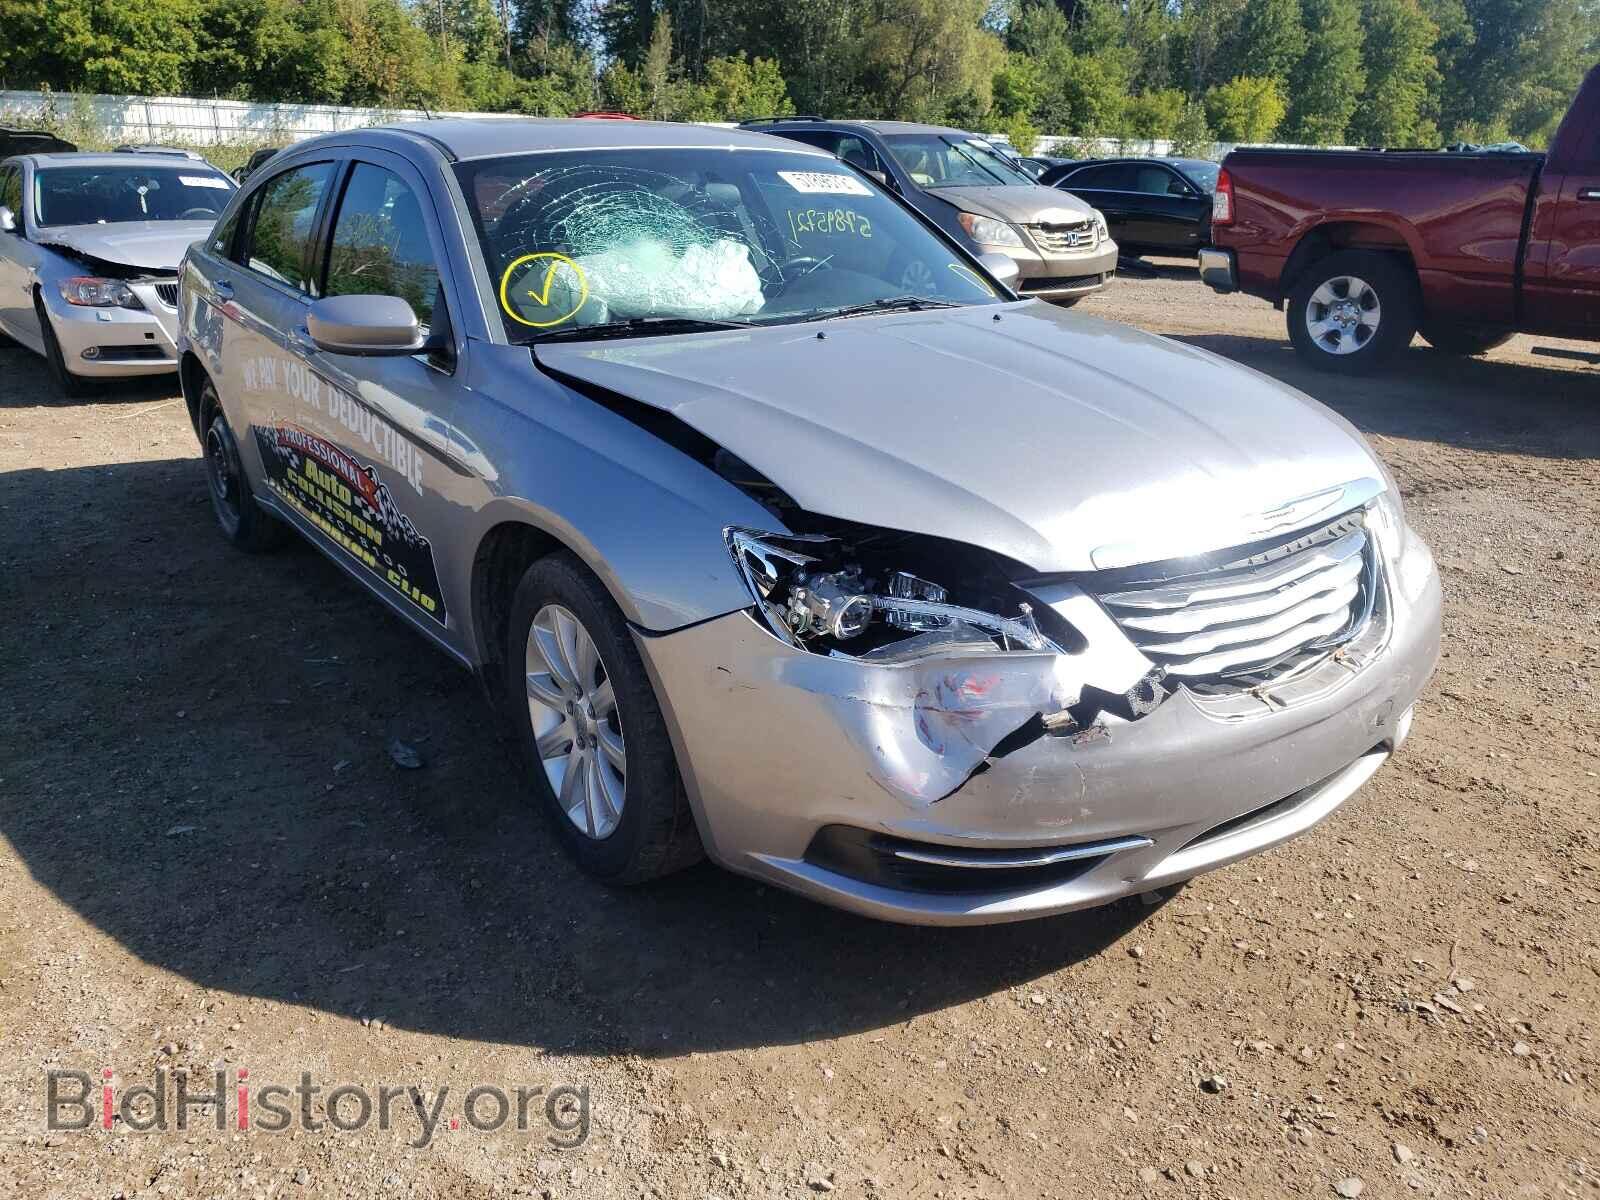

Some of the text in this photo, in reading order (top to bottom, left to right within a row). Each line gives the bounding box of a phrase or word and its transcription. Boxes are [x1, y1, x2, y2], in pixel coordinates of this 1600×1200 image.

[282, 359, 320, 410] YOUR
[328, 384, 424, 497] DEDUCTIBLE
[284, 427, 365, 492] PROFESSIONAL
[287, 467, 382, 545] COLLISION
[304, 457, 352, 506] Auto
[387, 569, 437, 611] CLIO
